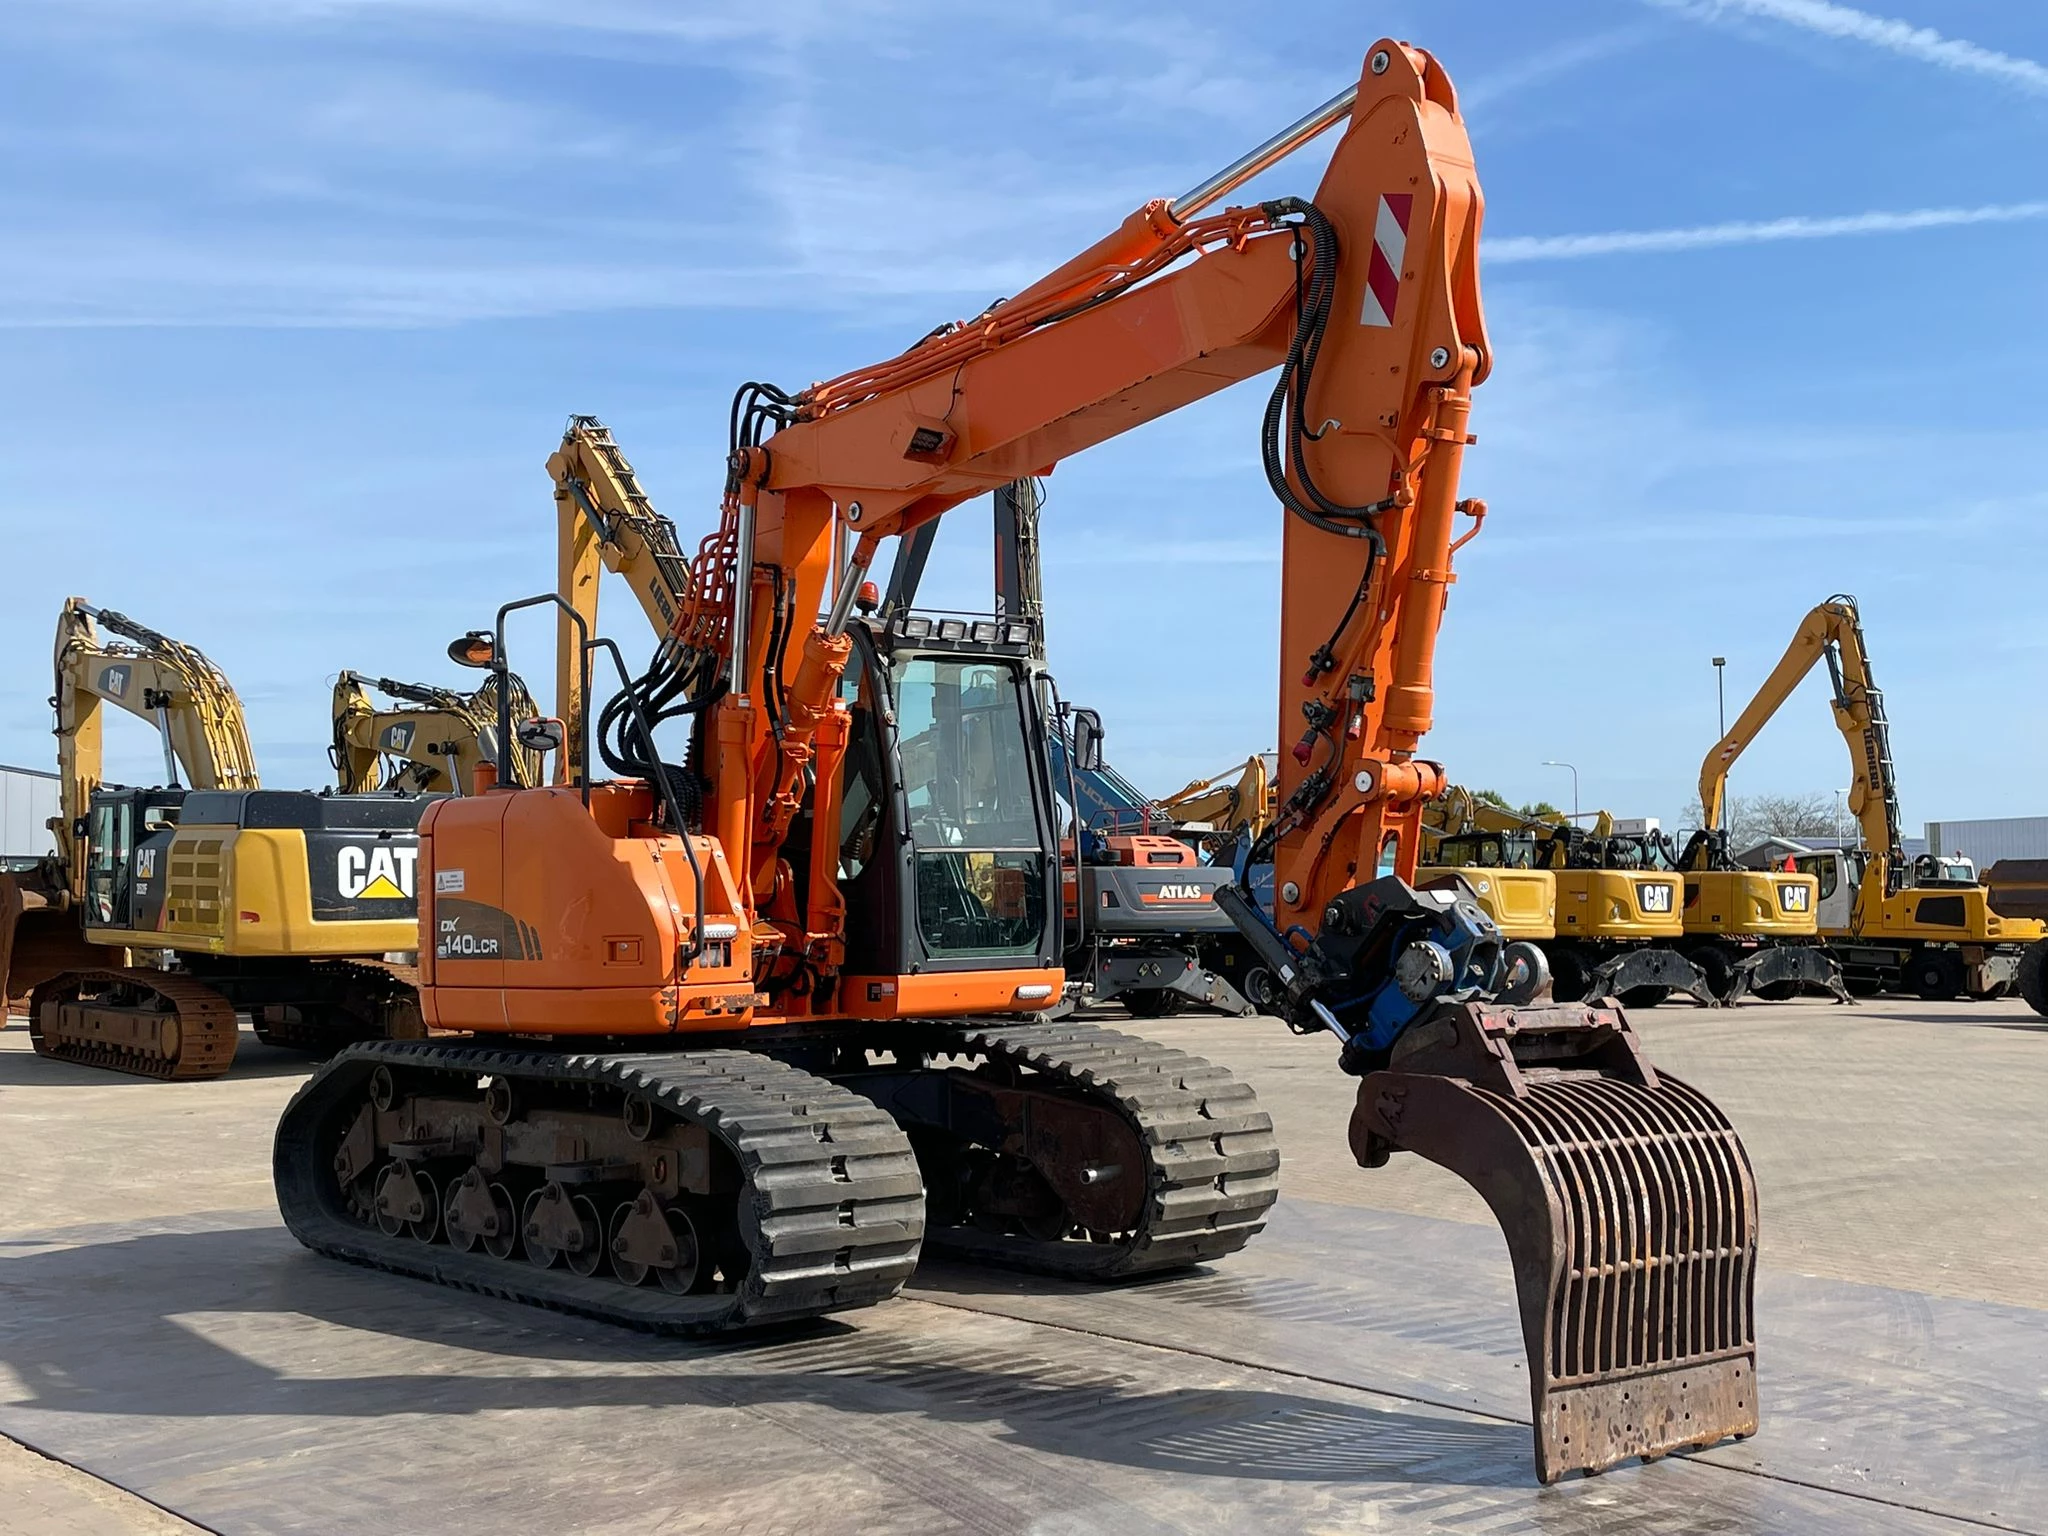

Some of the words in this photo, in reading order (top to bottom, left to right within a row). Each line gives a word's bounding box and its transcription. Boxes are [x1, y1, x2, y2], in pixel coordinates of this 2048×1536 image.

[109, 669, 124, 695] CAT
[391, 726, 407, 750] CAT
[1863, 728, 1880, 791] LIEBHERR
[137, 848, 156, 878] CAT
[338, 846, 418, 899] CAT
[1158, 885, 1201, 899] ATLAS
[1644, 885, 1669, 911] CAT
[1784, 886, 1806, 911] CAT
[440, 916, 460, 932] DX
